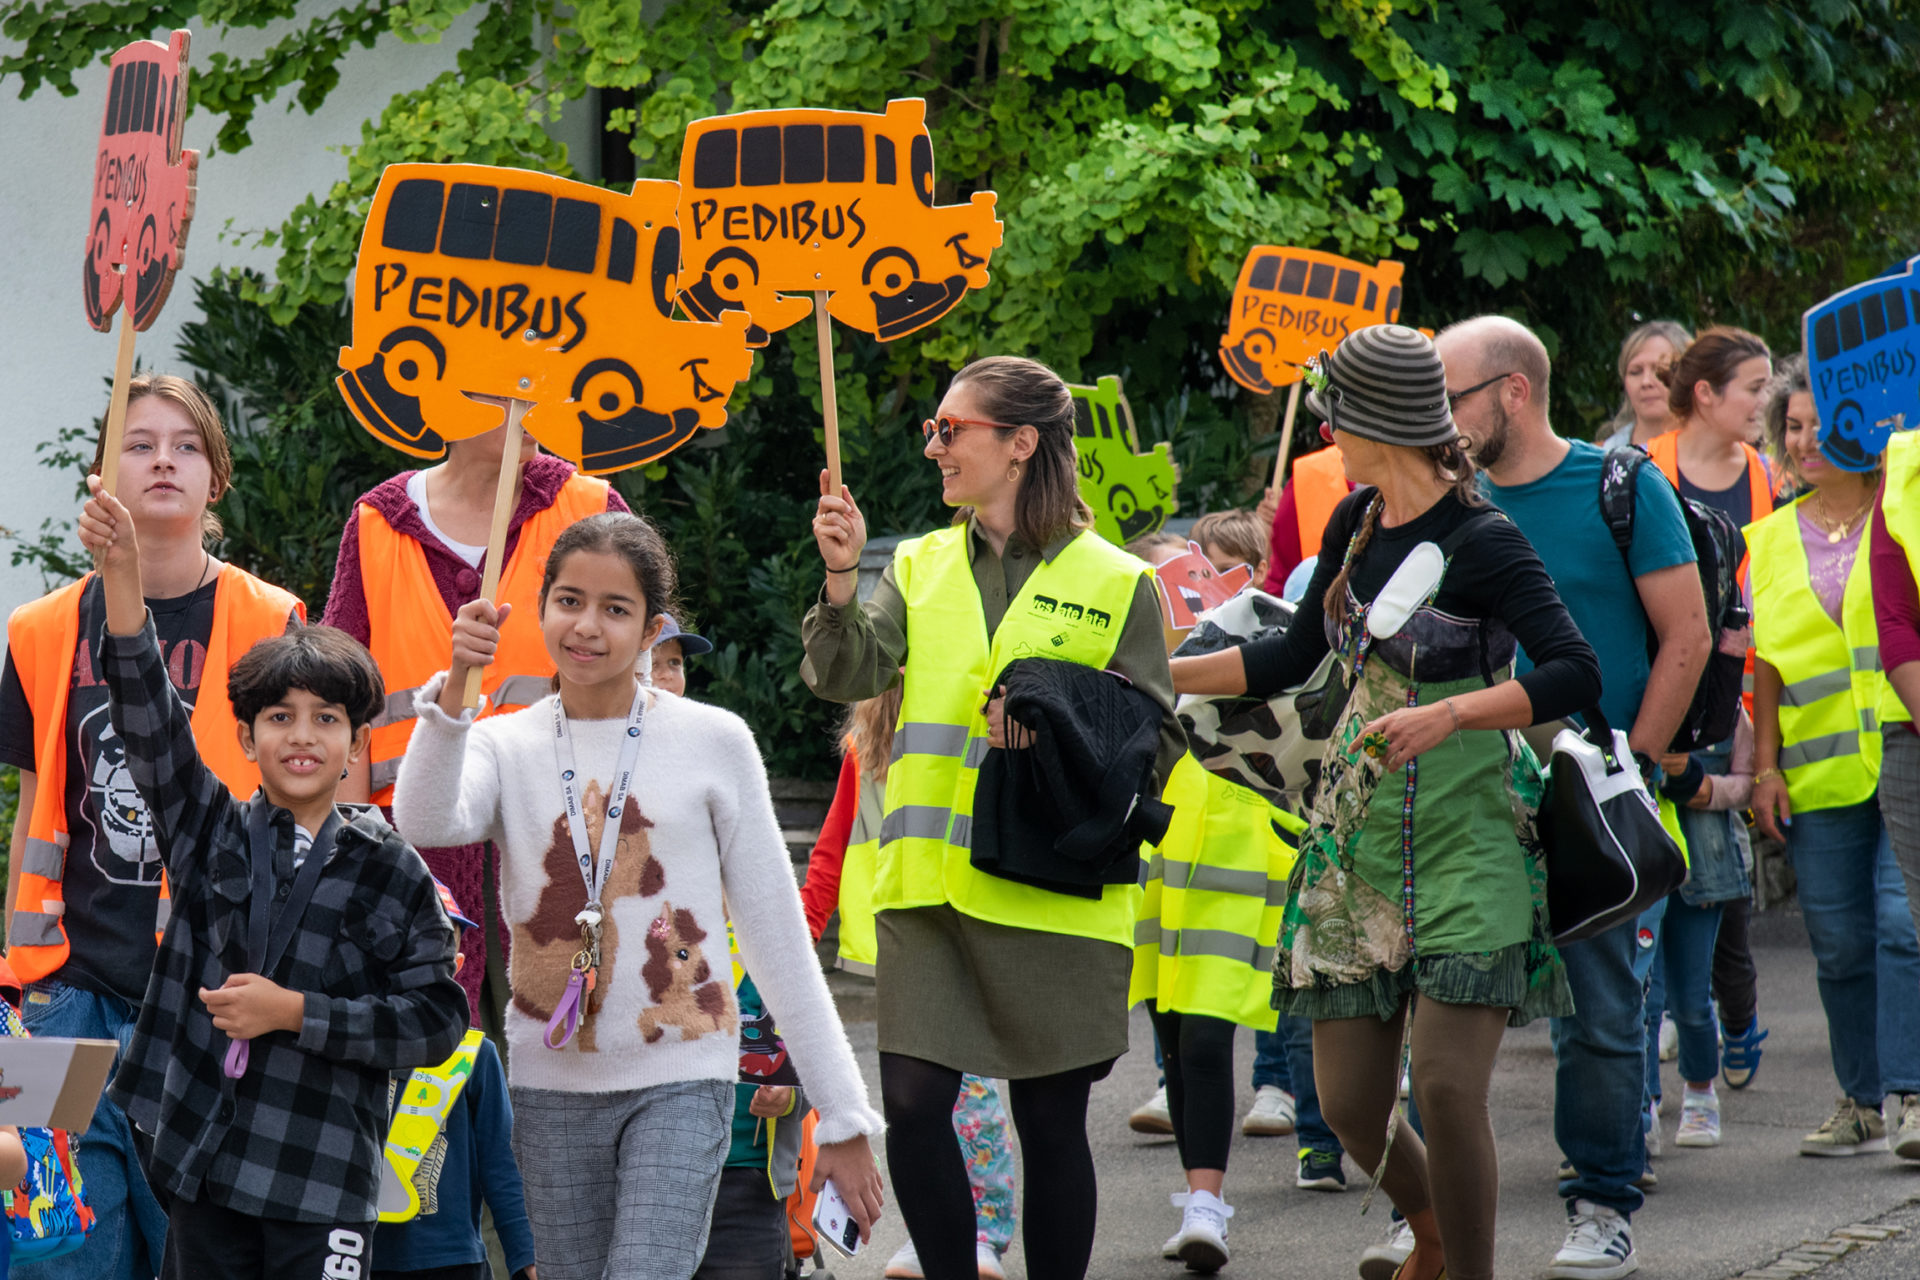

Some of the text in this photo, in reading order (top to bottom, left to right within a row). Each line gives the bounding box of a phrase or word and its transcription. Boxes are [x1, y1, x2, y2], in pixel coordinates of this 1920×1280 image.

[97, 149, 149, 213] PEDIBUS
[691, 198, 866, 248] PEDIBUS
[374, 262, 587, 353] PEDIBUS
[1242, 295, 1350, 345] PEDIBUS
[1818, 341, 1916, 401] PEDIBUS
[565, 786, 576, 816] DIMAB SA
[617, 771, 629, 801] DIMAB SA
